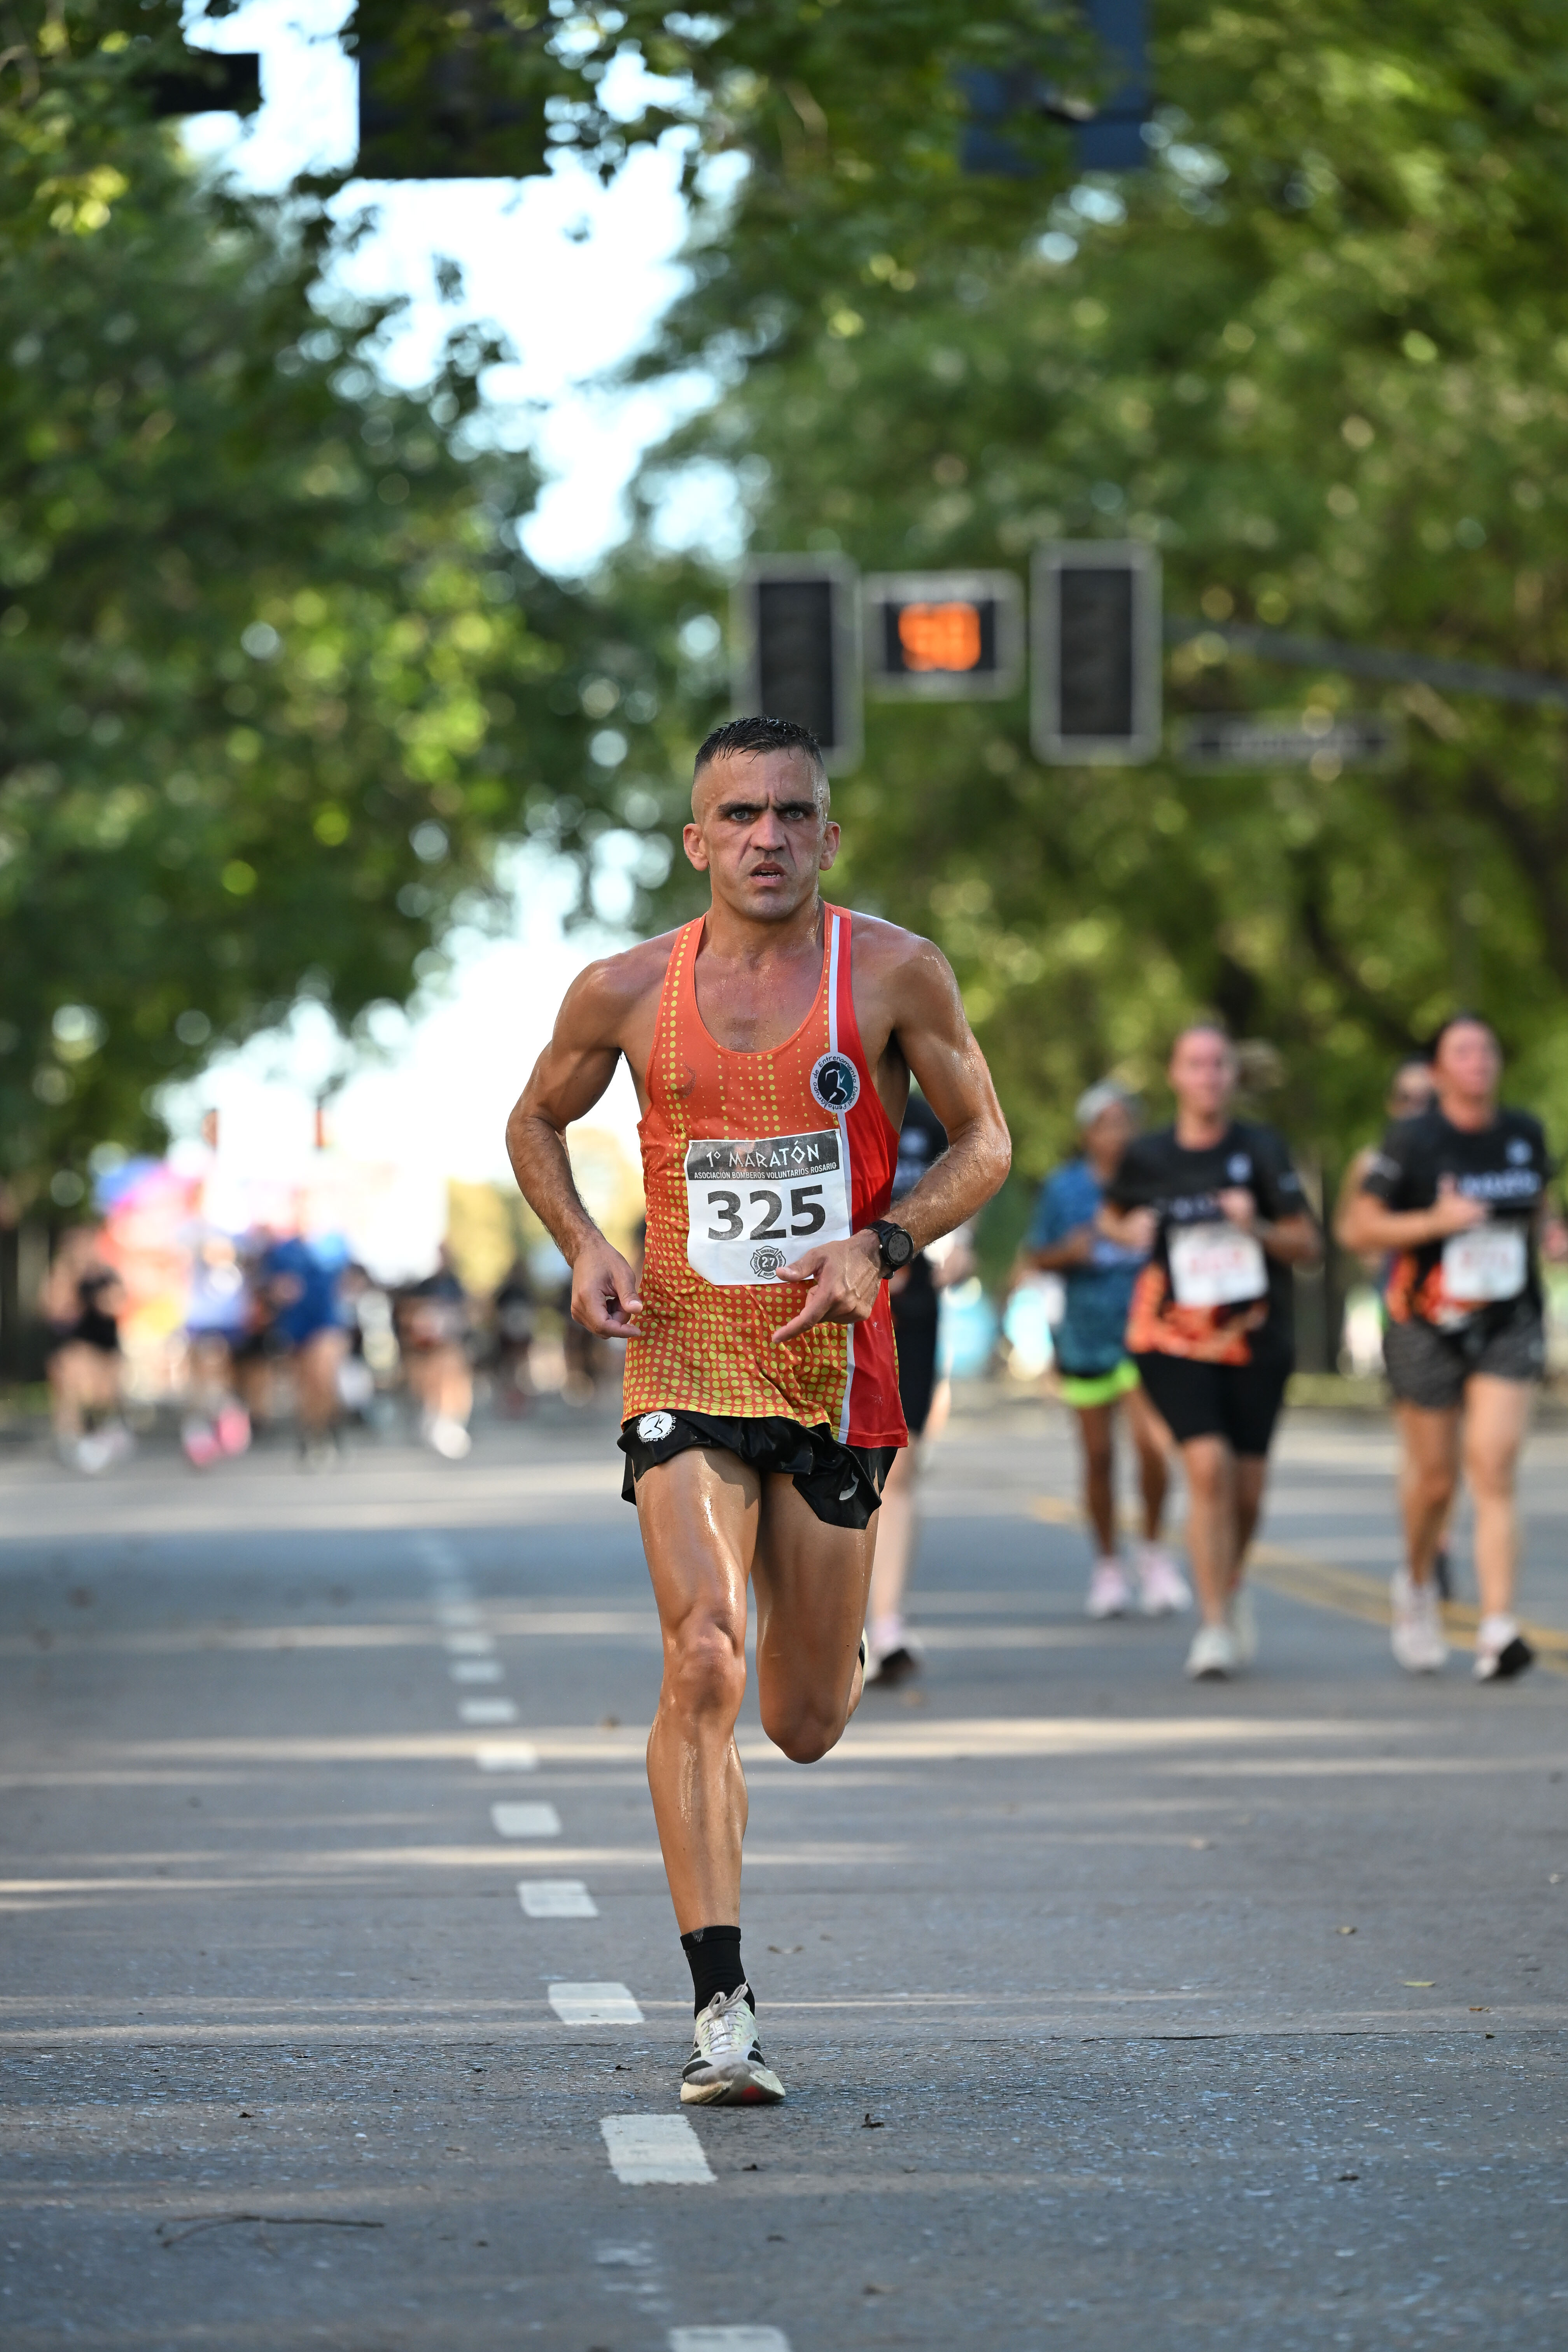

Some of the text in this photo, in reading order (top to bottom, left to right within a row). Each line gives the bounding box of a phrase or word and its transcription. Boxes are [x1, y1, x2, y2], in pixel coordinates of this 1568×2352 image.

[812, 1069, 819, 1079] de
[818, 1056, 856, 1083] Entrenamiento
[813, 1082, 826, 1104] Grupo
[847, 1087, 858, 1106] Daniel
[729, 1140, 819, 1168] MARATÓN
[694, 1170, 730, 1179] ASOCIACIÓN
[766, 1167, 808, 1179] VOLUNTARIOS
[810, 1162, 837, 1174] ROSARIO
[707, 1184, 826, 1241] 325
[762, 1256, 775, 1267] 27
[660, 1425, 676, 1440] Daniel
